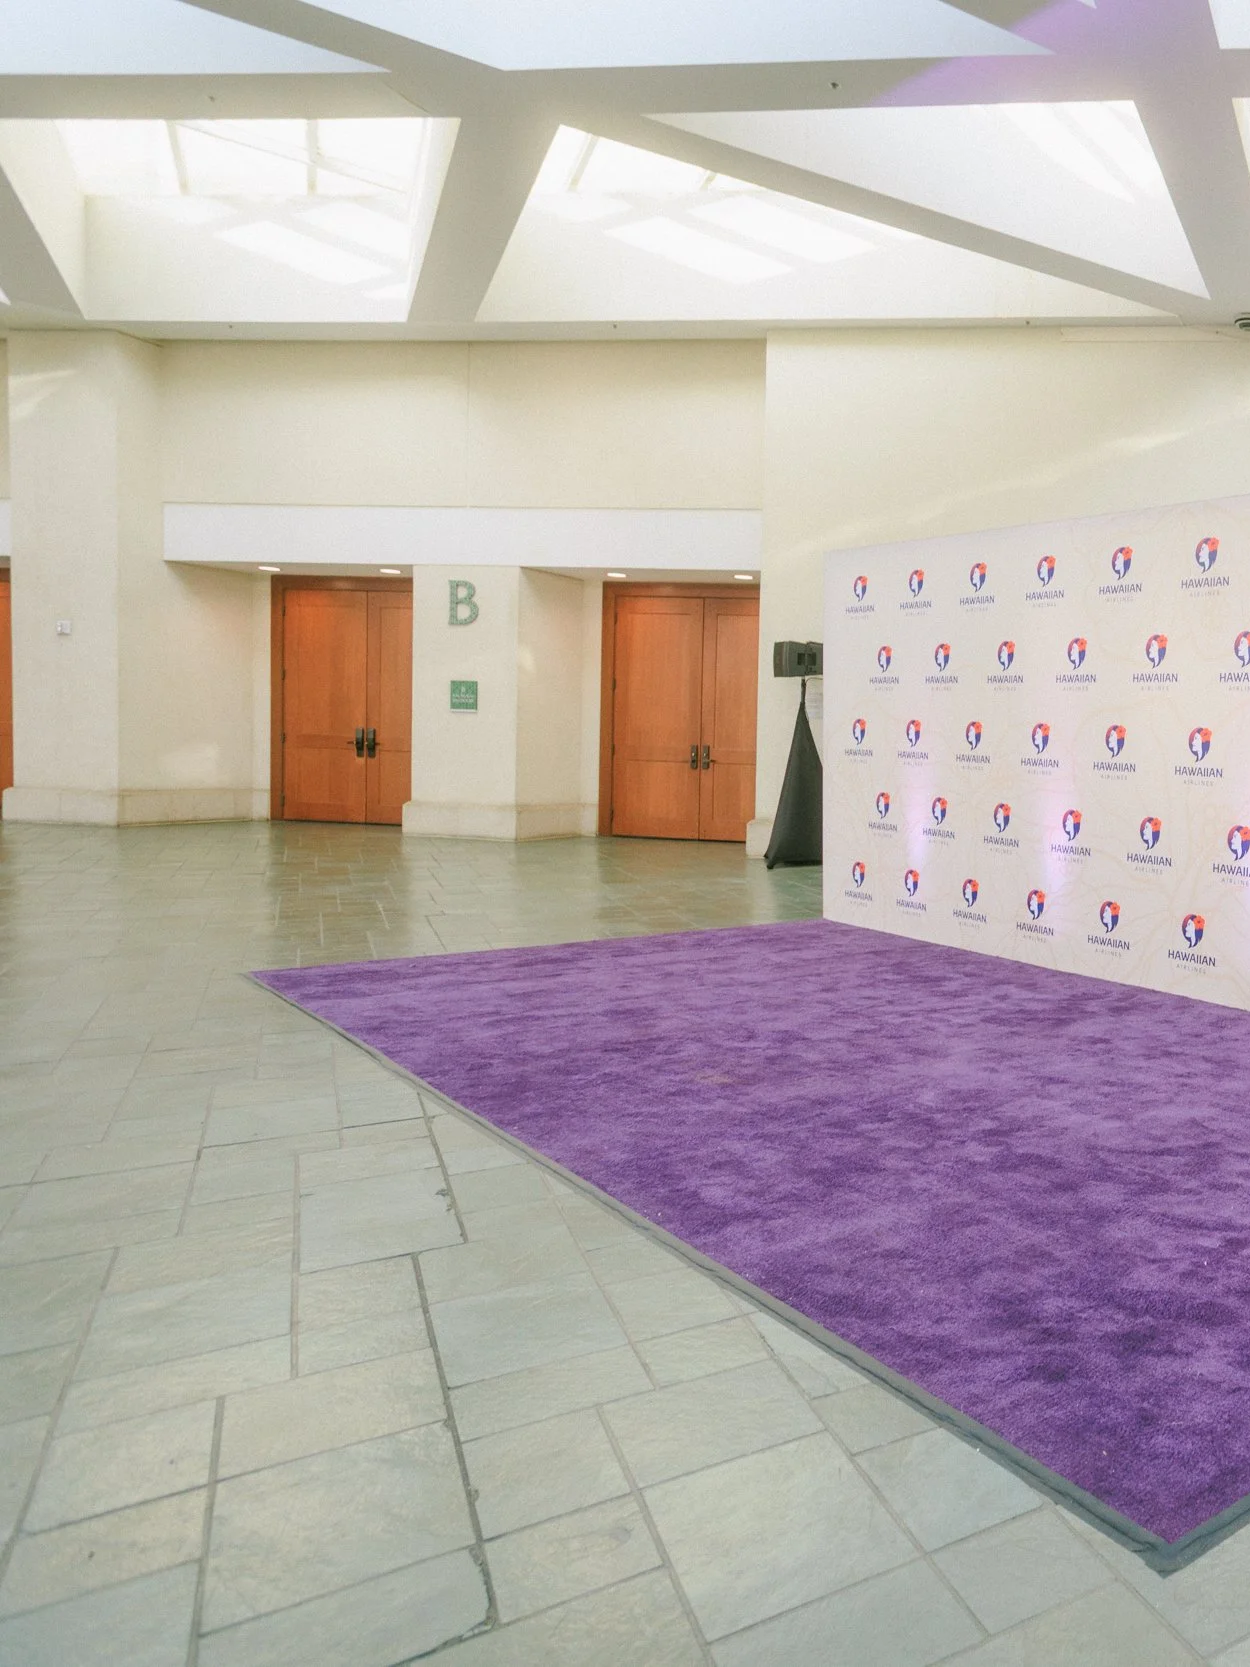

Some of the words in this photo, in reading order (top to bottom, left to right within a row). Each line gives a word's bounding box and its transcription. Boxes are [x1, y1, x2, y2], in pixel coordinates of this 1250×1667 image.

[1182, 576, 1229, 588] HAWAIIAN
[1099, 584, 1142, 594] HAWAIIAN
[1026, 590, 1064, 600] HAWAIIAN
[448, 580, 479, 625] B
[900, 601, 931, 609] HAWAIIAN
[960, 596, 994, 605] HAWAIIAN
[845, 604, 874, 614] HAWAIIAN
[869, 675, 899, 685] HAWAIIAN
[925, 675, 958, 684] HAWAIIAN
[988, 675, 1023, 683] HAWAIIAN
[1056, 674, 1096, 683] HAWAIIAN
[1133, 673, 1177, 682] HAWAIIAN
[845, 748, 873, 757] HAWAIIAN
[898, 751, 928, 759] HAWAIIAN
[956, 754, 990, 763] HAWAIIAN
[1021, 758, 1059, 767] HAWAIIAN
[1093, 762, 1135, 772] HAWAIIAN
[1175, 766, 1222, 778] HAWAIIAN
[869, 822, 897, 831] HAWAIIAN
[923, 828, 955, 839] HAWAIIAN
[984, 836, 1019, 848] HAWAIIAN
[1051, 844, 1091, 856] HAWAIIAN
[1127, 853, 1171, 867] HAWAIIAN
[845, 890, 872, 901] HAWAIIAN
[897, 899, 926, 911] HAWAIIAN
[953, 910, 986, 923] HAWAIIAN
[1016, 922, 1053, 936] HAWAIIAN
[1088, 935, 1129, 950] HAWAIIAN
[1168, 949, 1215, 967] HAWAIIAN
